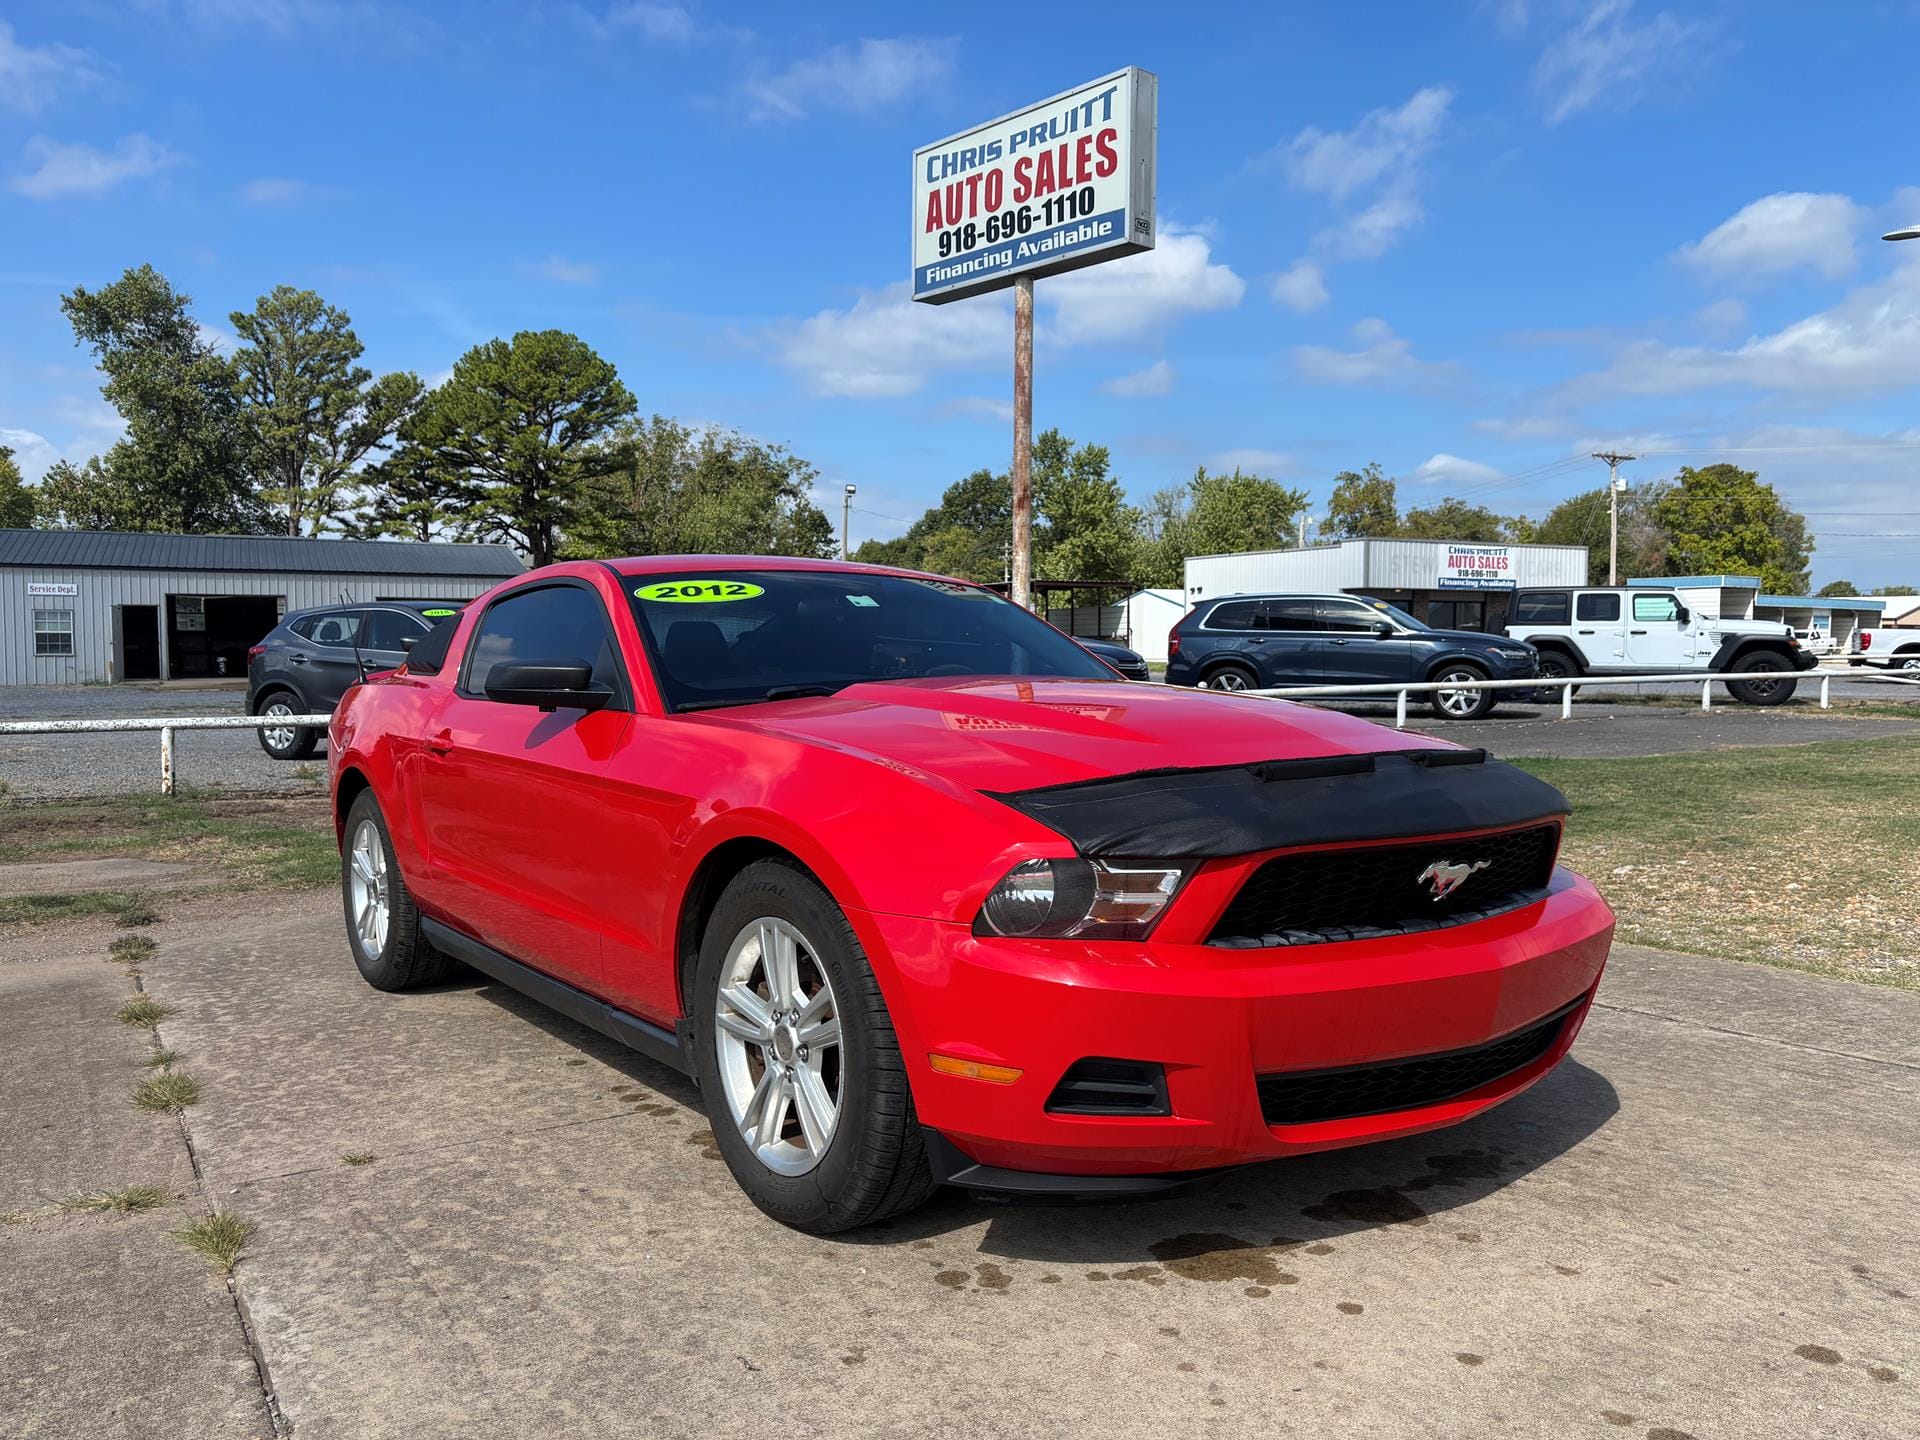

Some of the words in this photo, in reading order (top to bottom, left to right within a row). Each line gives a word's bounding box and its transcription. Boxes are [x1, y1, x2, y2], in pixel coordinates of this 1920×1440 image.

[927, 138, 1002, 183] CHRIS
[1009, 85, 1118, 154] PRUITT
[925, 167, 1003, 233] AUTO
[1013, 128, 1118, 203] SALES
[938, 185, 1095, 258] 918-696-1110
[926, 248, 1013, 285] Financing
[1016, 219, 1112, 259] Available
[1448, 555, 1475, 569] AUTO
[1478, 556, 1508, 570] SALES
[29, 585, 56, 593] Service
[57, 585, 76, 594] Dept.
[655, 584, 748, 598] 2012
[1440, 578, 1478, 588] Financing
